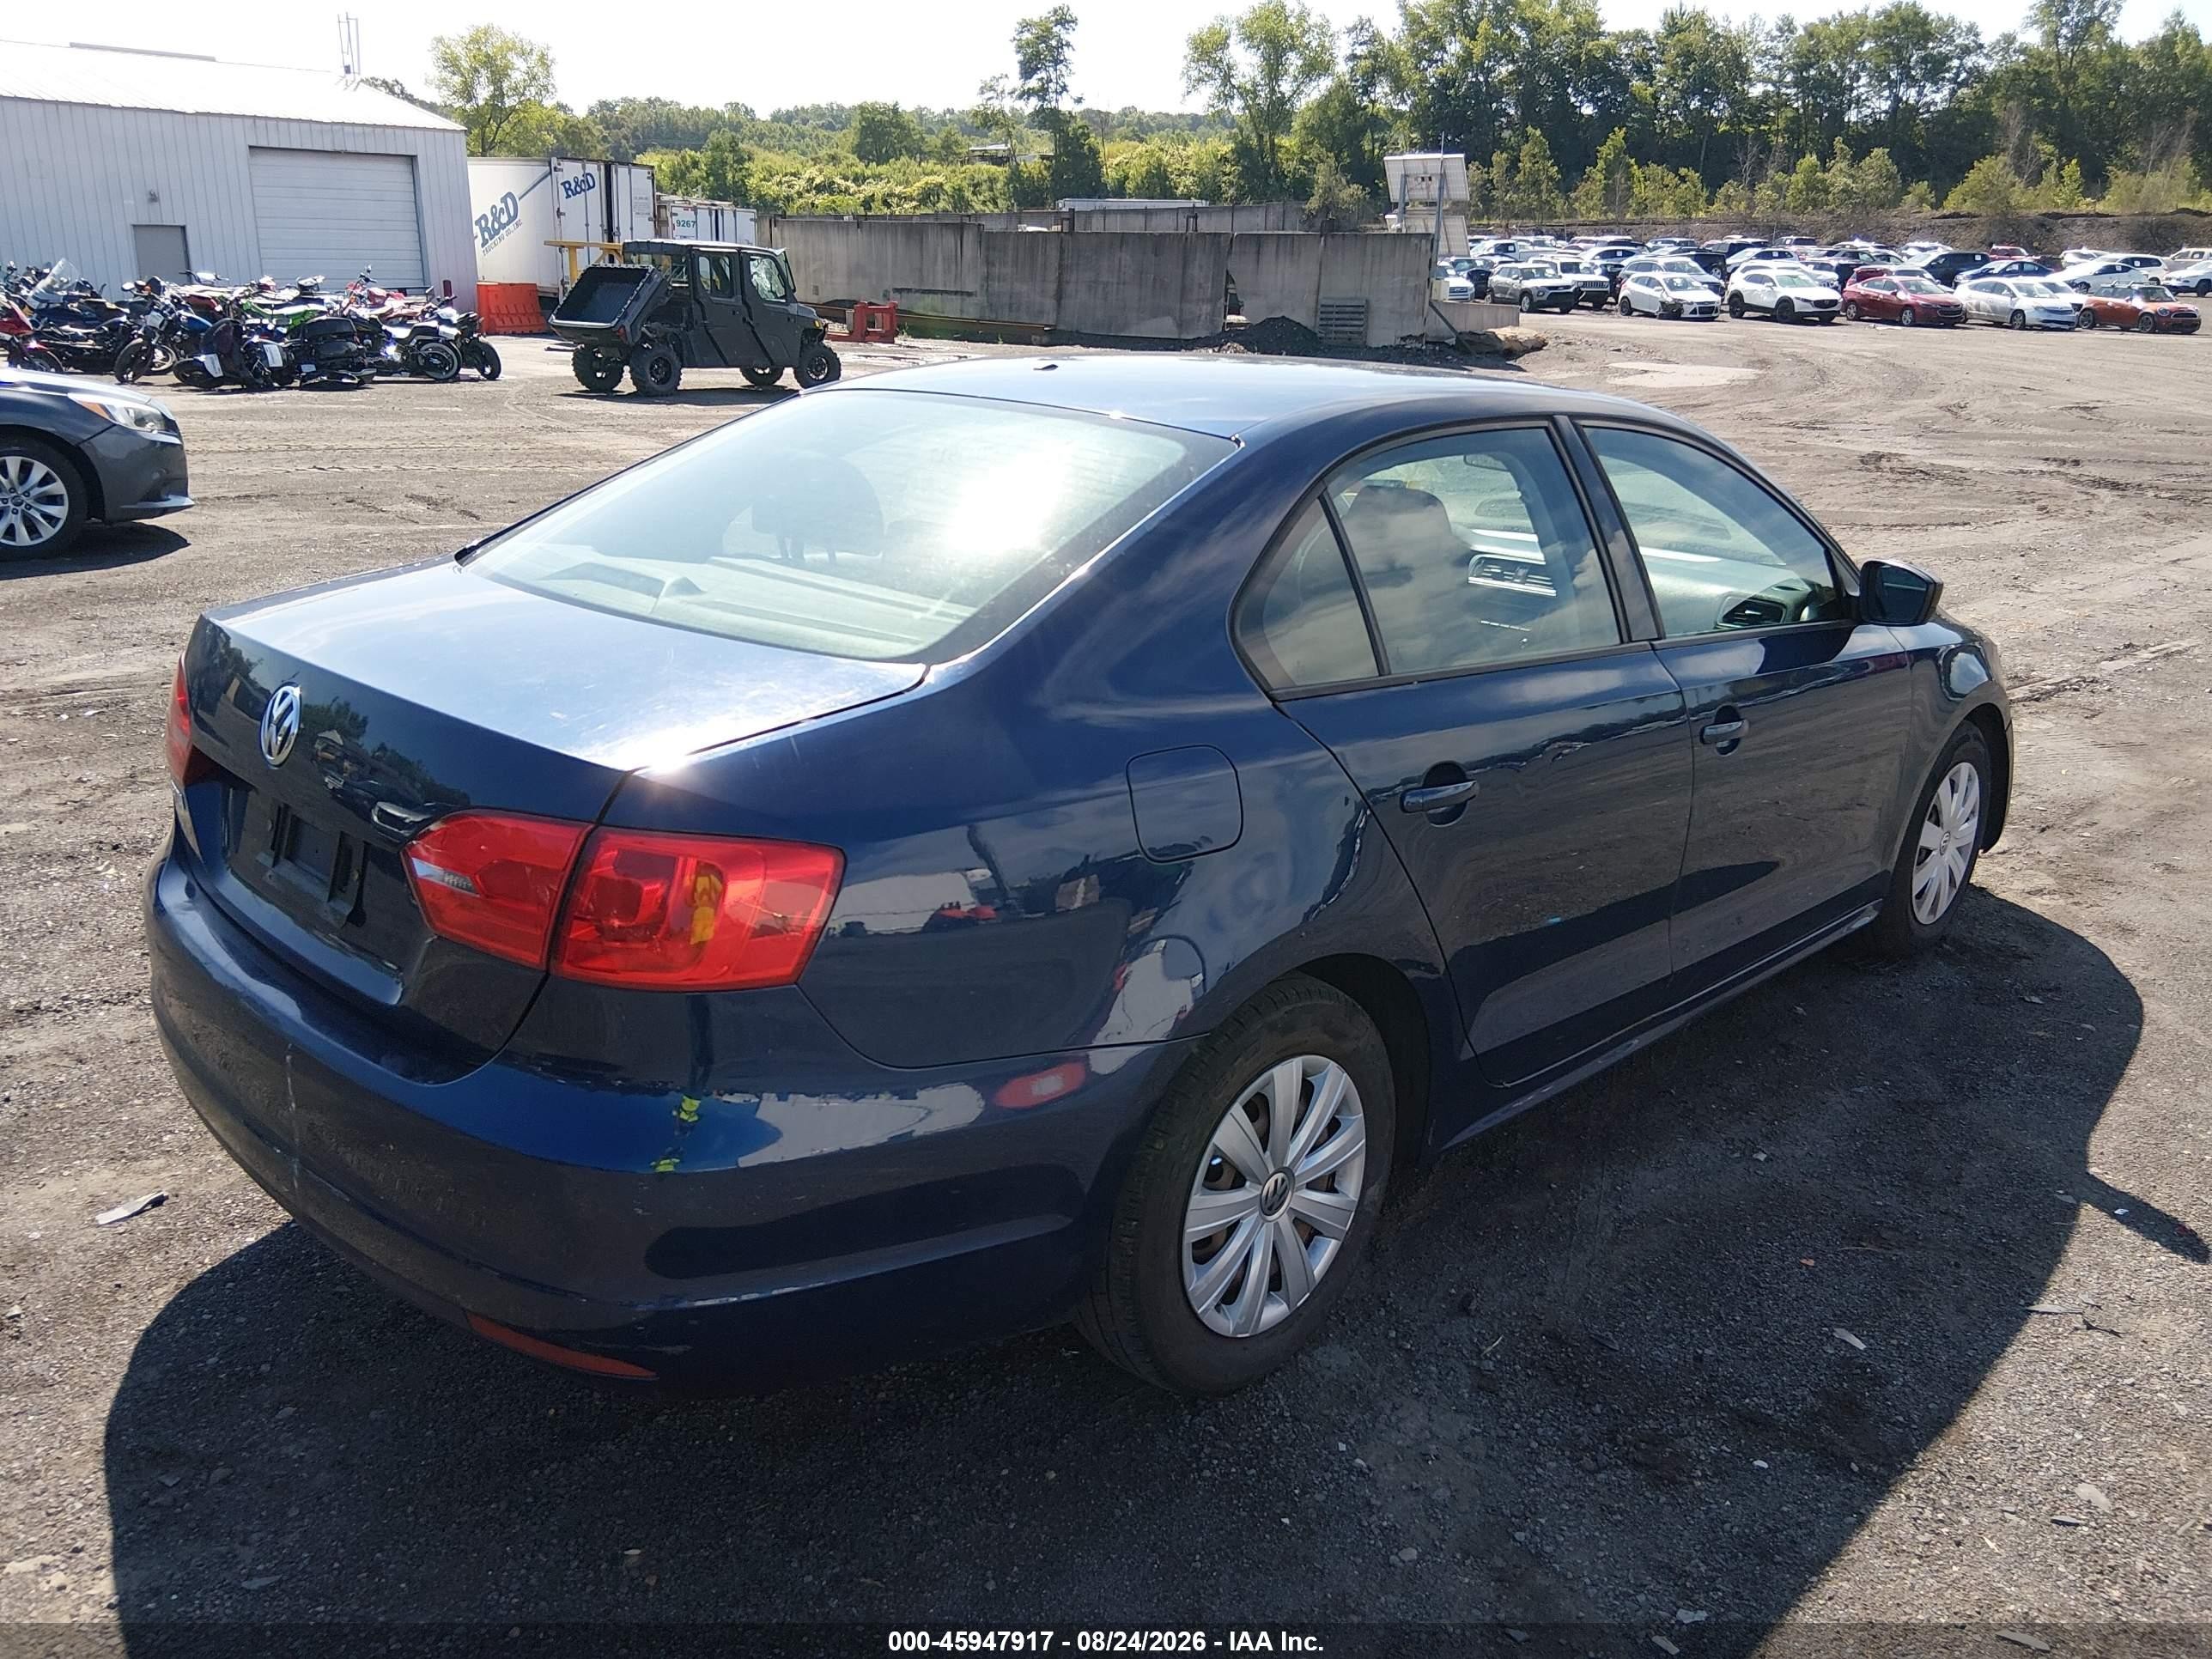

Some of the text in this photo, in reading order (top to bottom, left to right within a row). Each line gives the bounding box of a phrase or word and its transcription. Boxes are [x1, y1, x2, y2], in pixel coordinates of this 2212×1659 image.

[560, 172, 596, 199] R&D
[474, 191, 519, 249] R&D
[676, 219, 696, 228] 9267
